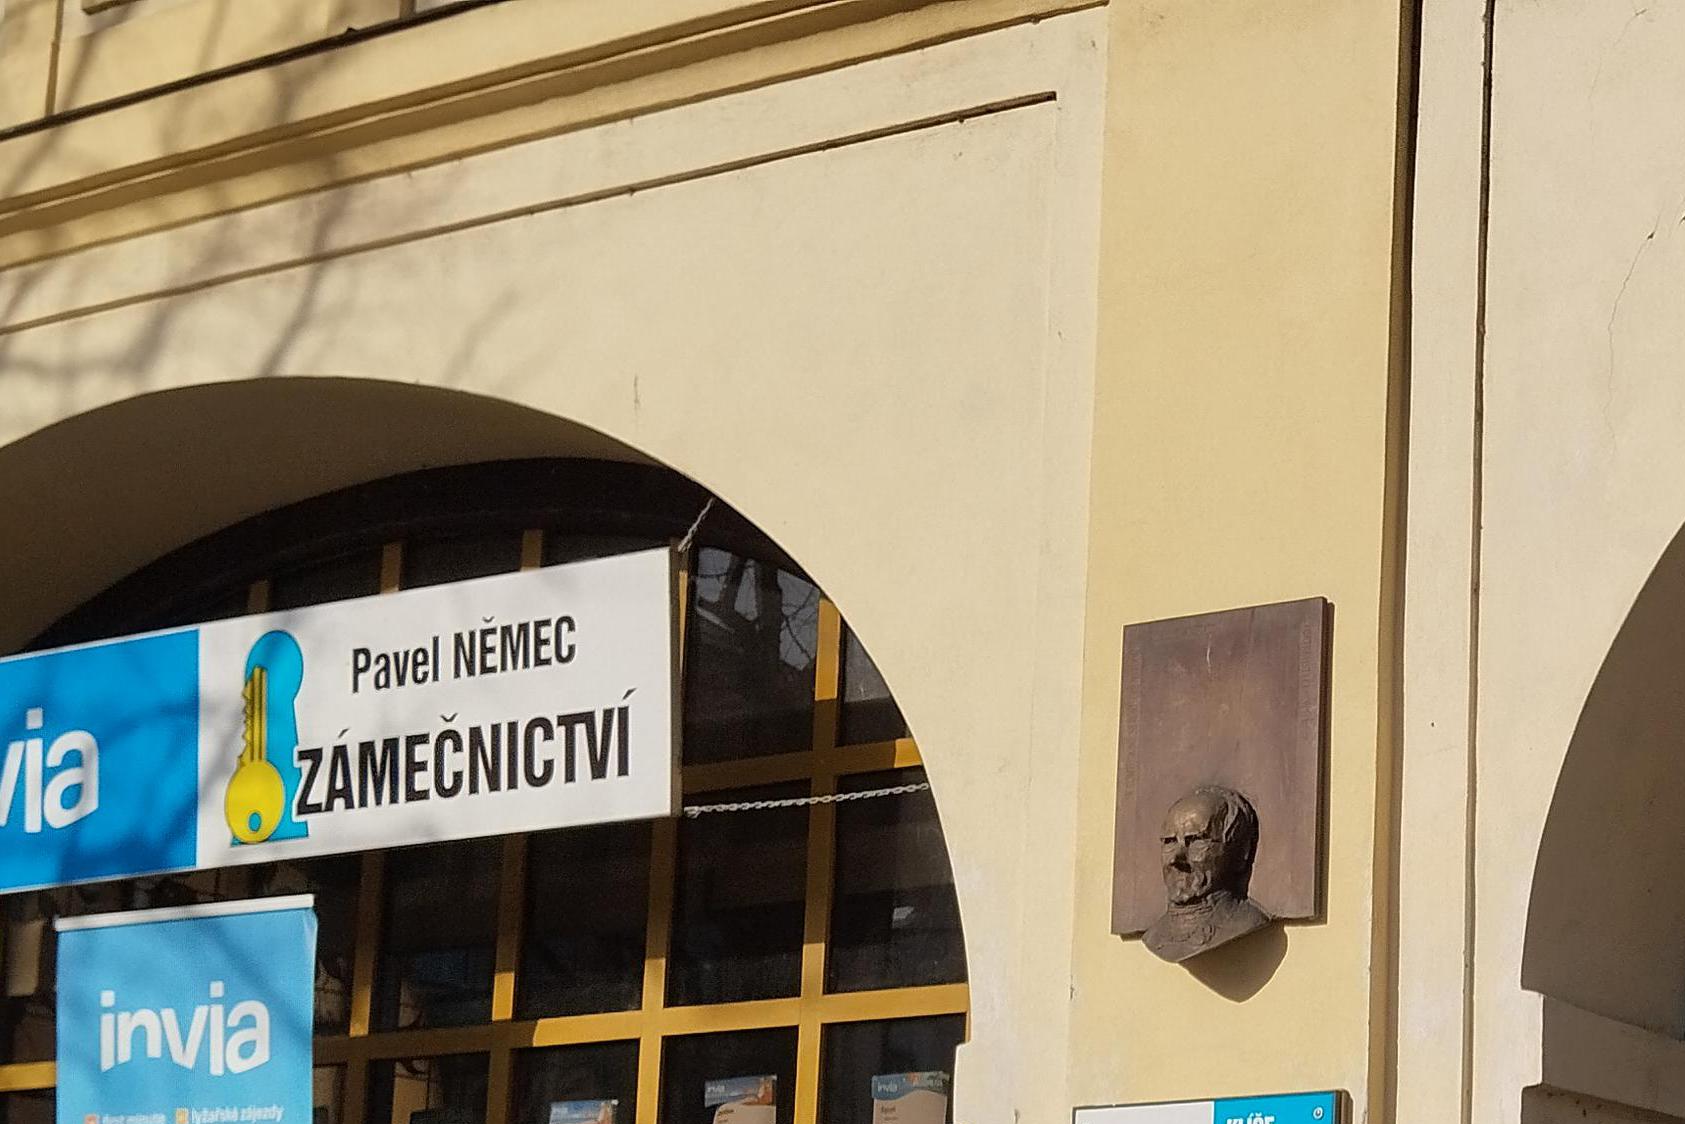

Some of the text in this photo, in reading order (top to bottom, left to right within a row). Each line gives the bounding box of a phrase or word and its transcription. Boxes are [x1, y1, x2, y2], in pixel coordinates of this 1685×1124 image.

[351, 615, 577, 693] Pavel NĚMEC
[296, 688, 637, 816] ZÁMEČNICTVÍ
[100, 981, 270, 1076] invia
